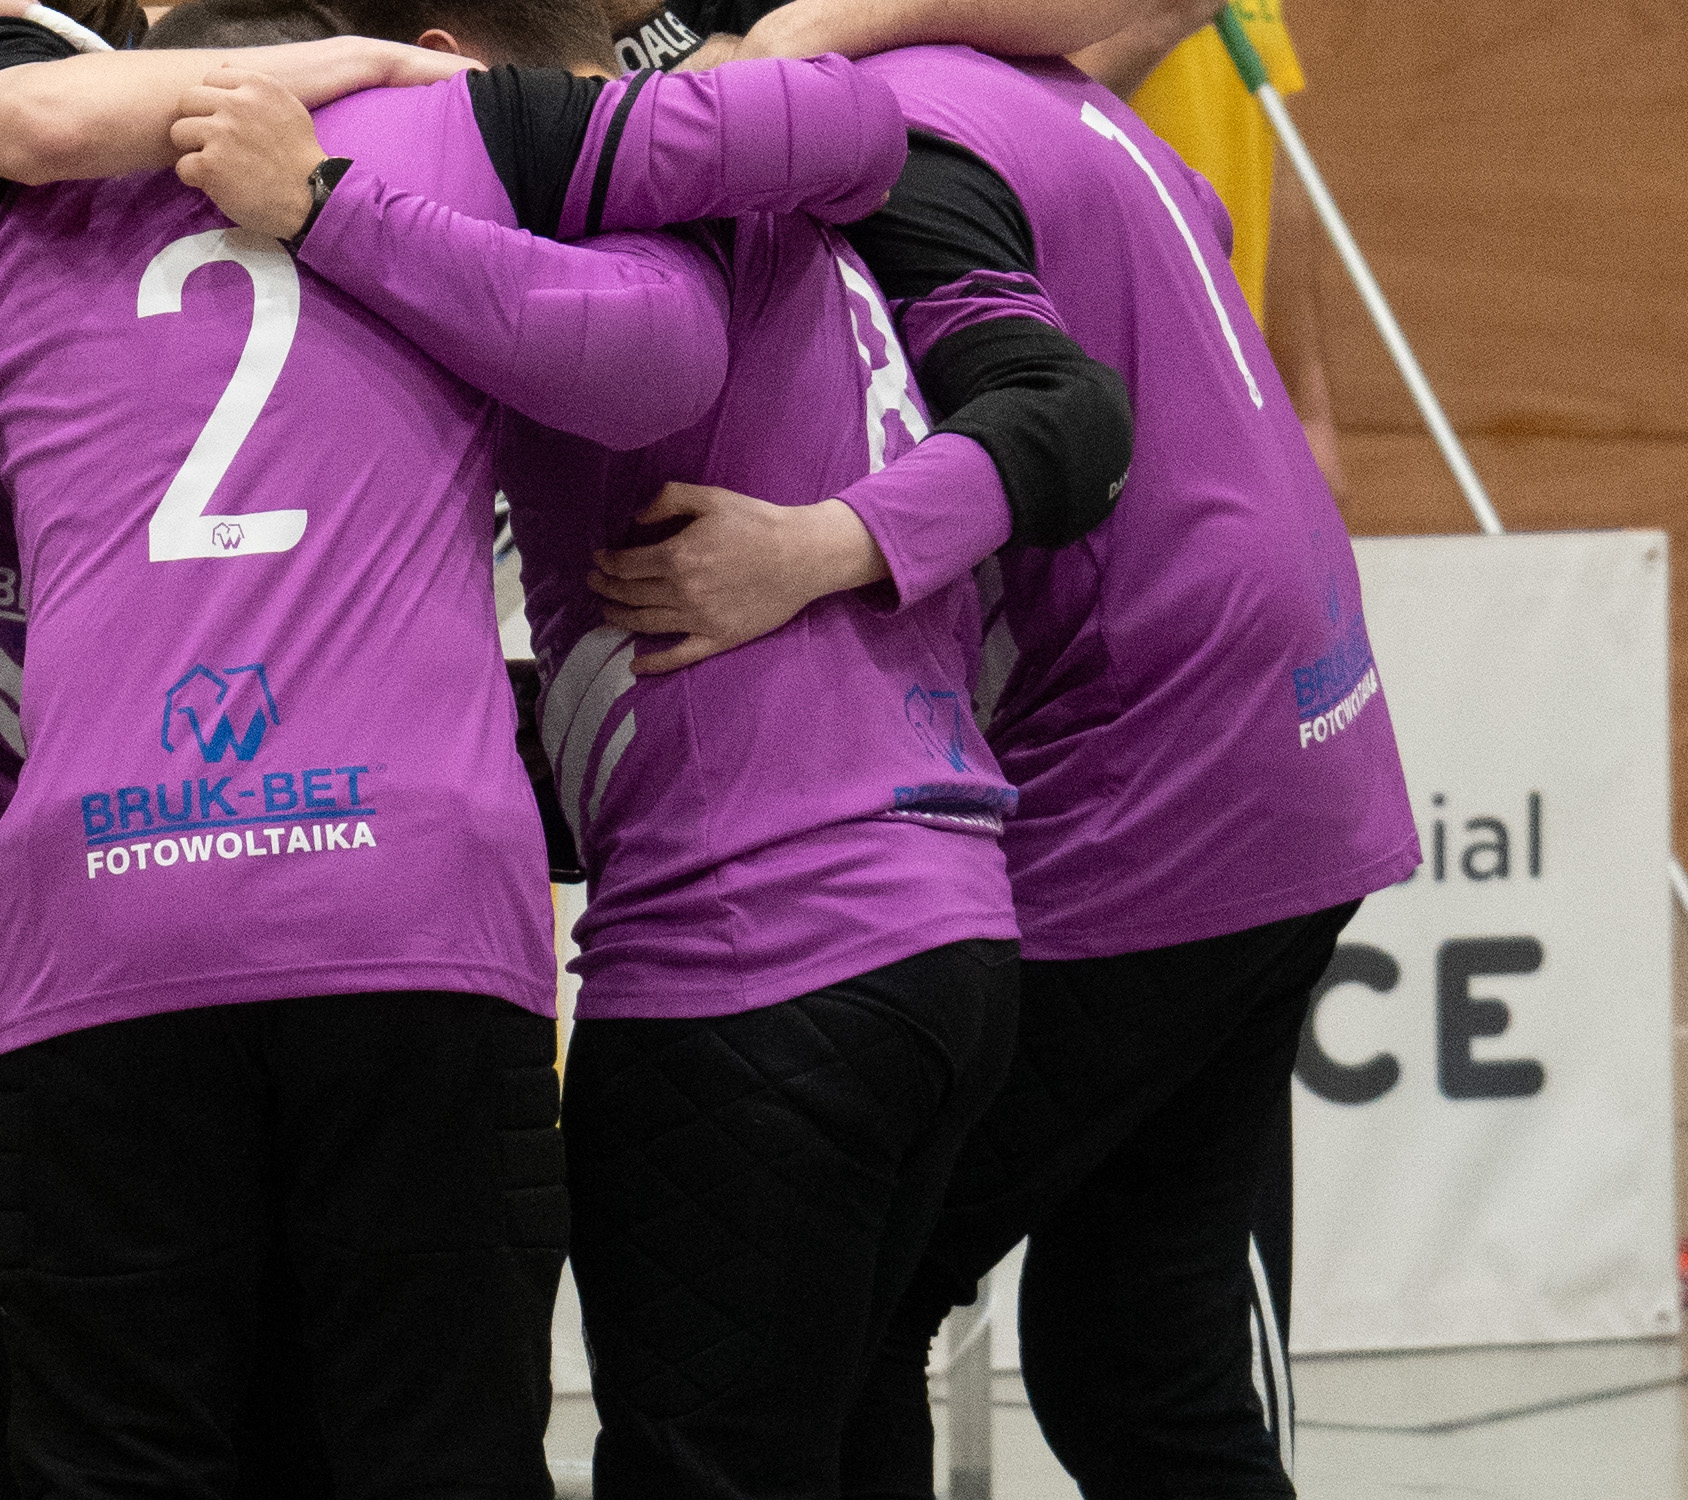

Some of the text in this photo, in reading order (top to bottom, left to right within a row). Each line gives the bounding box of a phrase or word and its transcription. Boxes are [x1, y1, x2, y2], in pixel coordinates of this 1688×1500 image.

[137, 226, 308, 562] 2
[80, 766, 369, 837] BRUK-BET
[86, 821, 377, 879] FOTOWOLTAIKA
